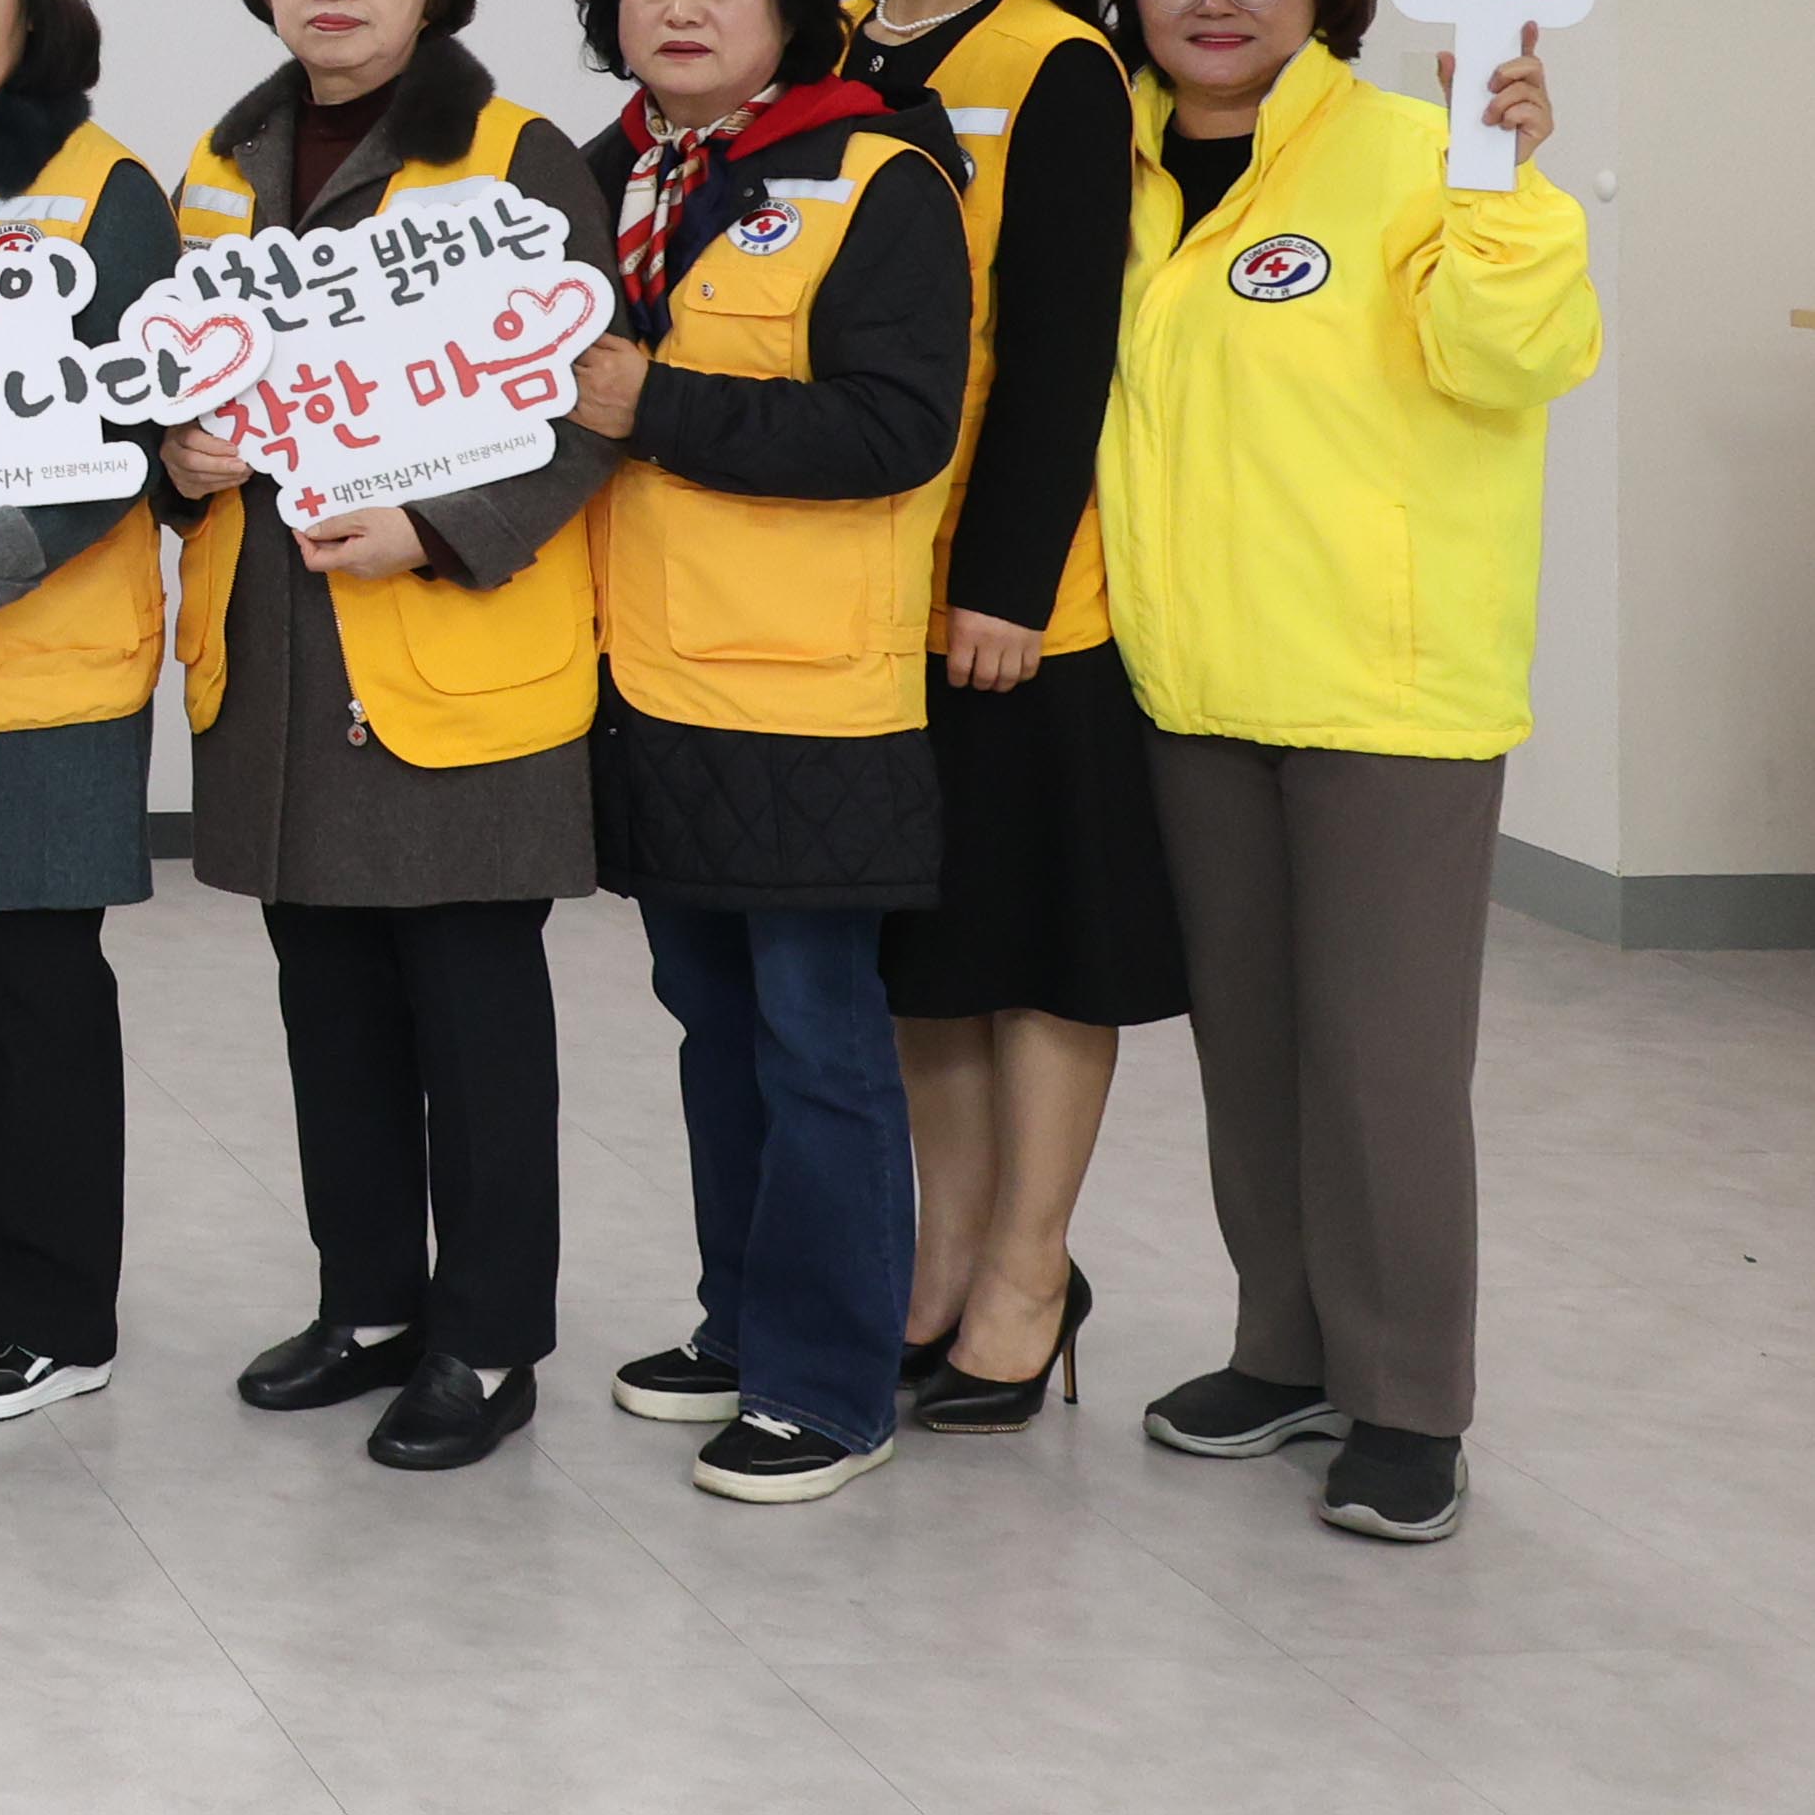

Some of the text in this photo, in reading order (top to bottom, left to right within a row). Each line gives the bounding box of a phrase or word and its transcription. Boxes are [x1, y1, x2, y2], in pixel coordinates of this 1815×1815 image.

[370, 197, 551, 305] 밝히는
[214, 308, 560, 473] 착한 마음
[39, 458, 130, 480] 인천광역시지사
[331, 432, 538, 505] 대한적십자사 인천광역시지사
